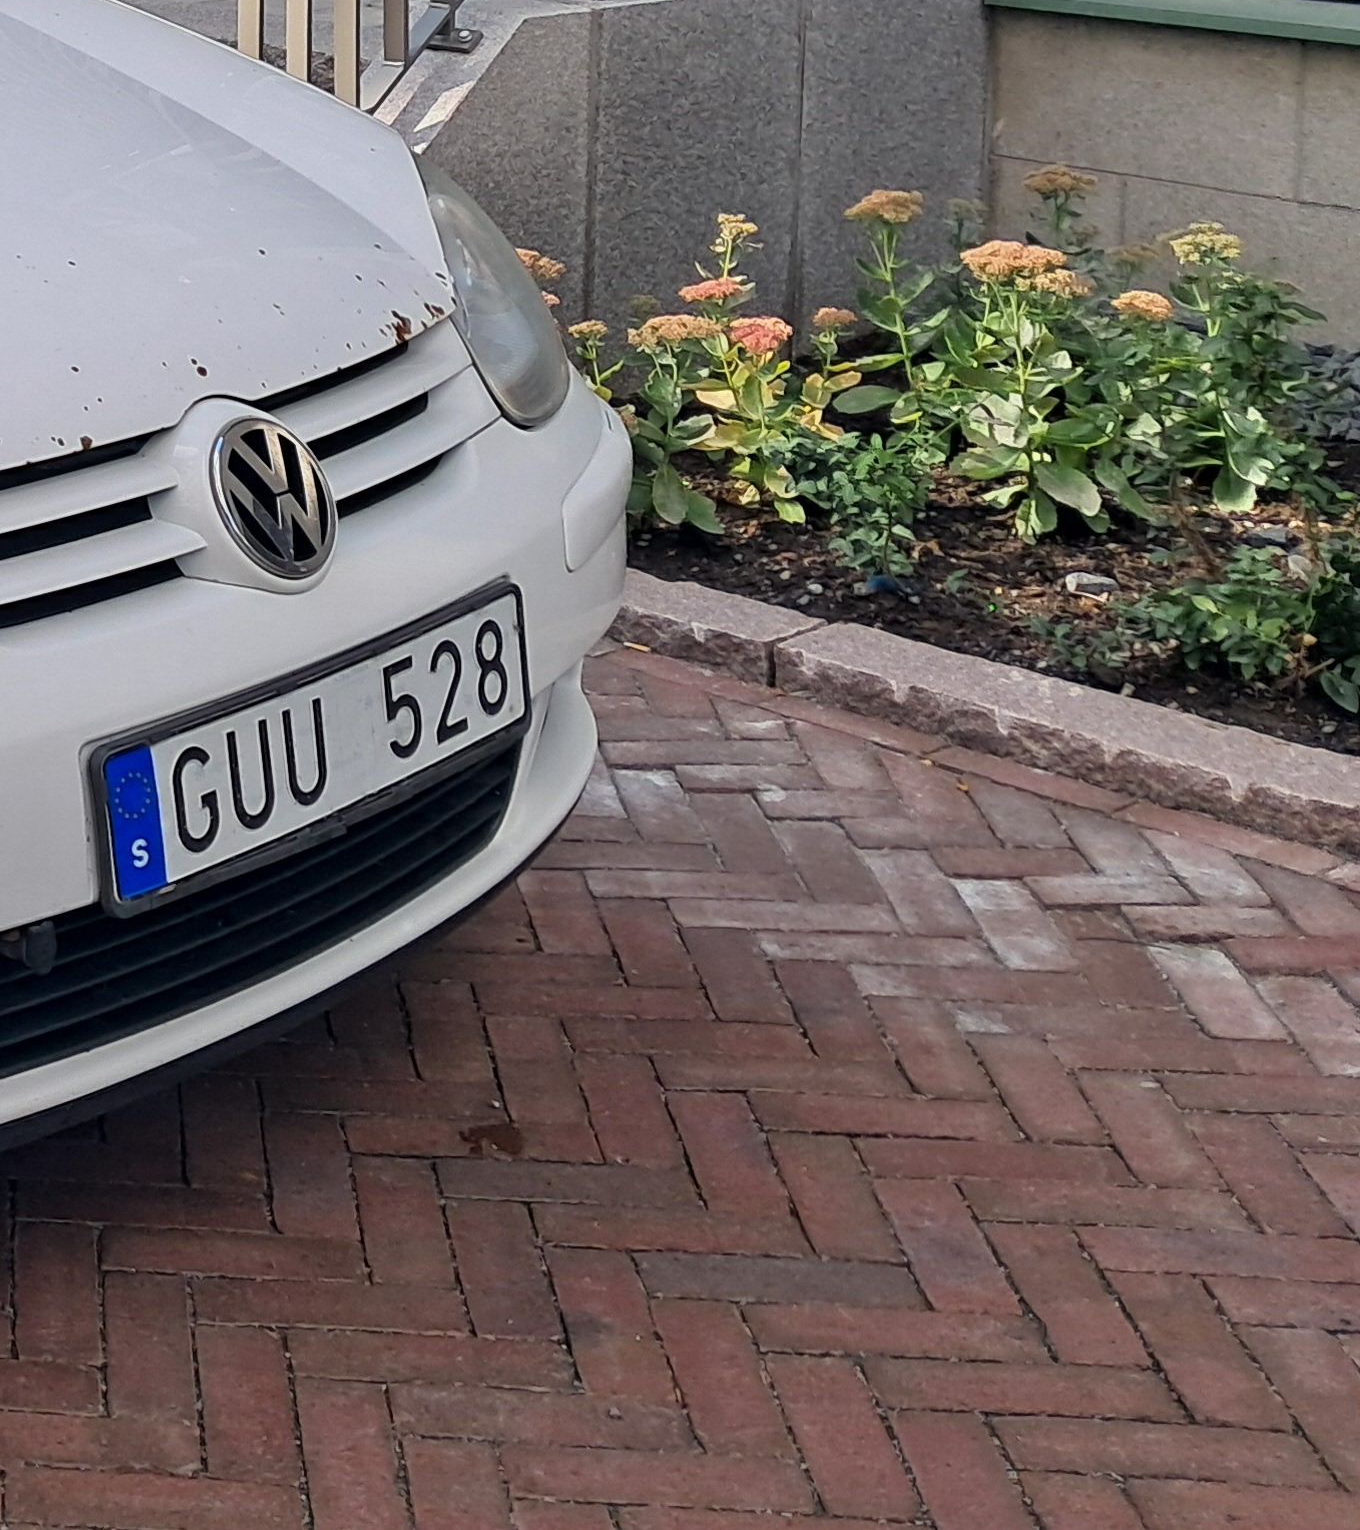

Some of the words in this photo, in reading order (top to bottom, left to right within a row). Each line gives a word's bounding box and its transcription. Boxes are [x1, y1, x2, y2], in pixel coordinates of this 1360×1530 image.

[214, 420, 332, 574] VW
[172, 698, 328, 854] GUU
[382, 619, 509, 759] 528
[131, 838, 150, 869] S
